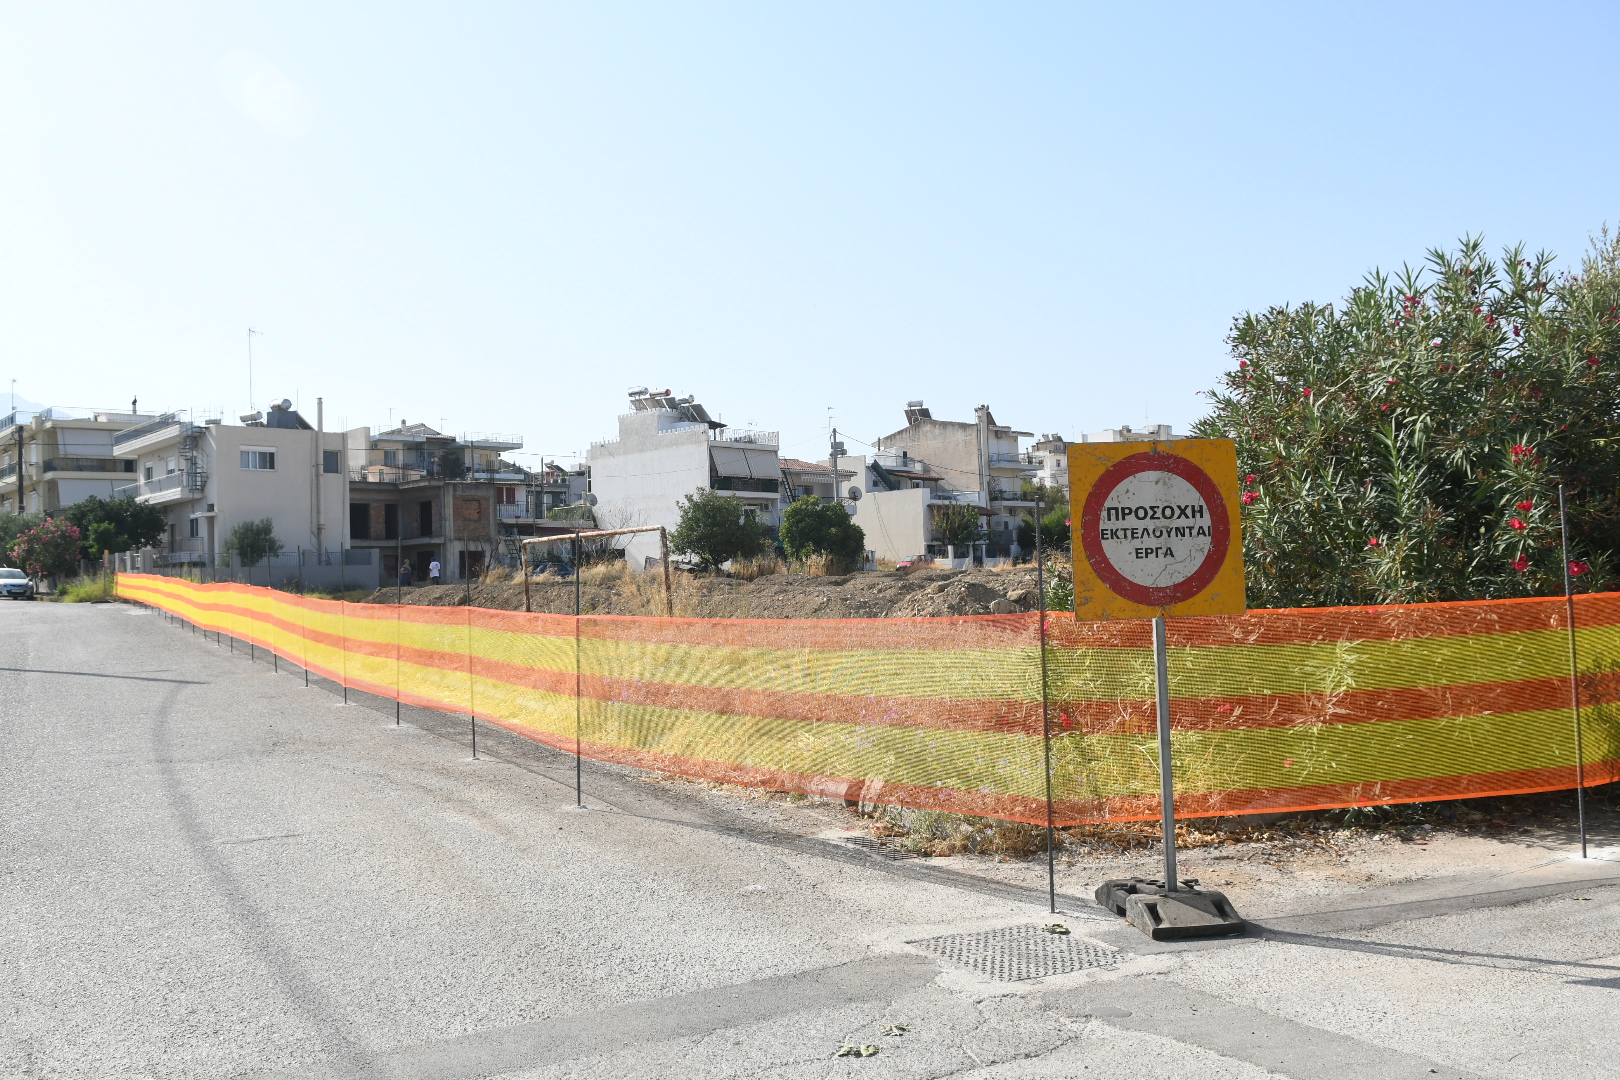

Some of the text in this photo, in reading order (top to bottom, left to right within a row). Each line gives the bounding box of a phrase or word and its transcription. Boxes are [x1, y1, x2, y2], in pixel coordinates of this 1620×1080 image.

[1106, 505, 1204, 521] ΠΡΟΣΟΧΗ
[1100, 525, 1212, 540] ΕΚΤΕΛΟΥΝΤΑΙ
[1135, 546, 1175, 559] ΕΡΓΑ
